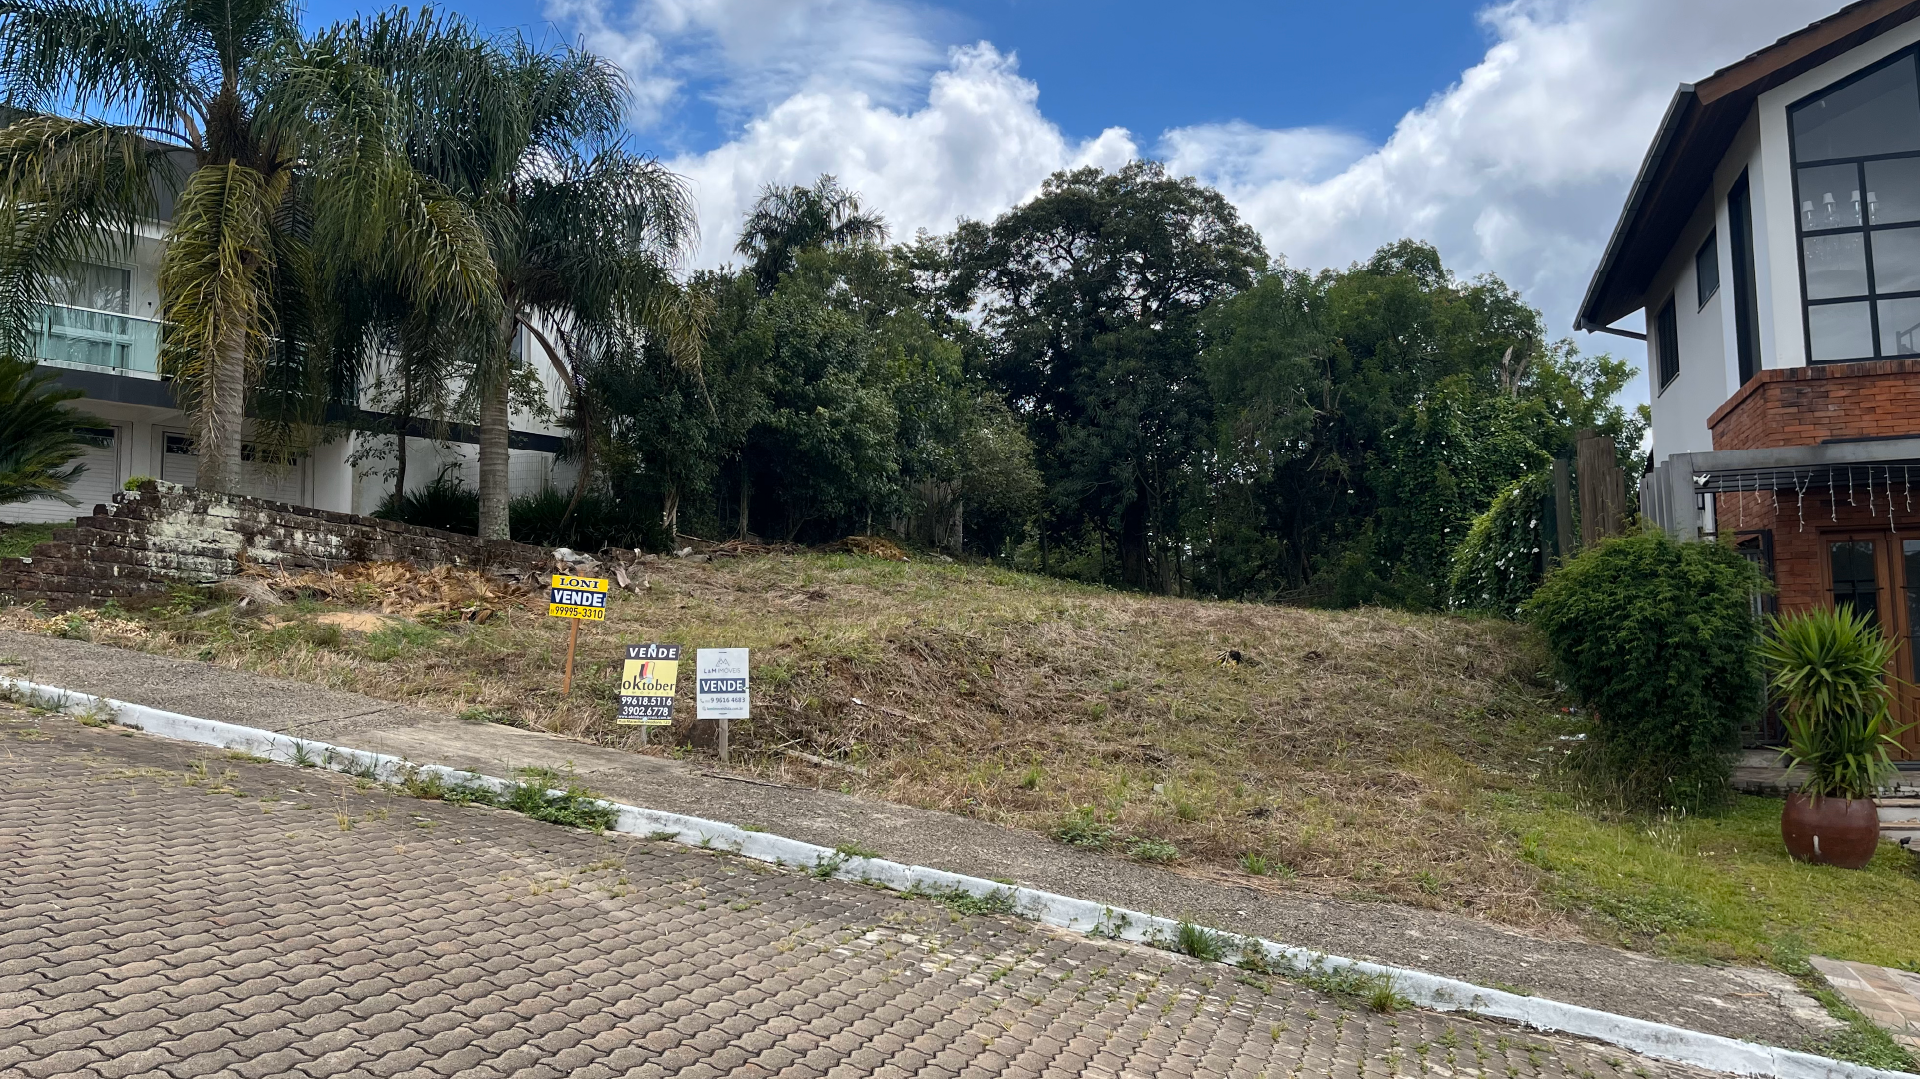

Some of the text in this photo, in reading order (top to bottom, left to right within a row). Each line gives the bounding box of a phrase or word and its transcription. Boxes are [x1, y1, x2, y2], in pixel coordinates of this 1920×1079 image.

[560, 578, 599, 588] LONI
[554, 590, 603, 606] VENDE
[555, 606, 603, 619] 99995-3310
[629, 647, 677, 658] VENDE
[622, 675, 675, 691] oktober
[701, 680, 743, 692] VENDE
[621, 696, 672, 706] 99618.5116
[622, 706, 669, 716] 3902.6778
